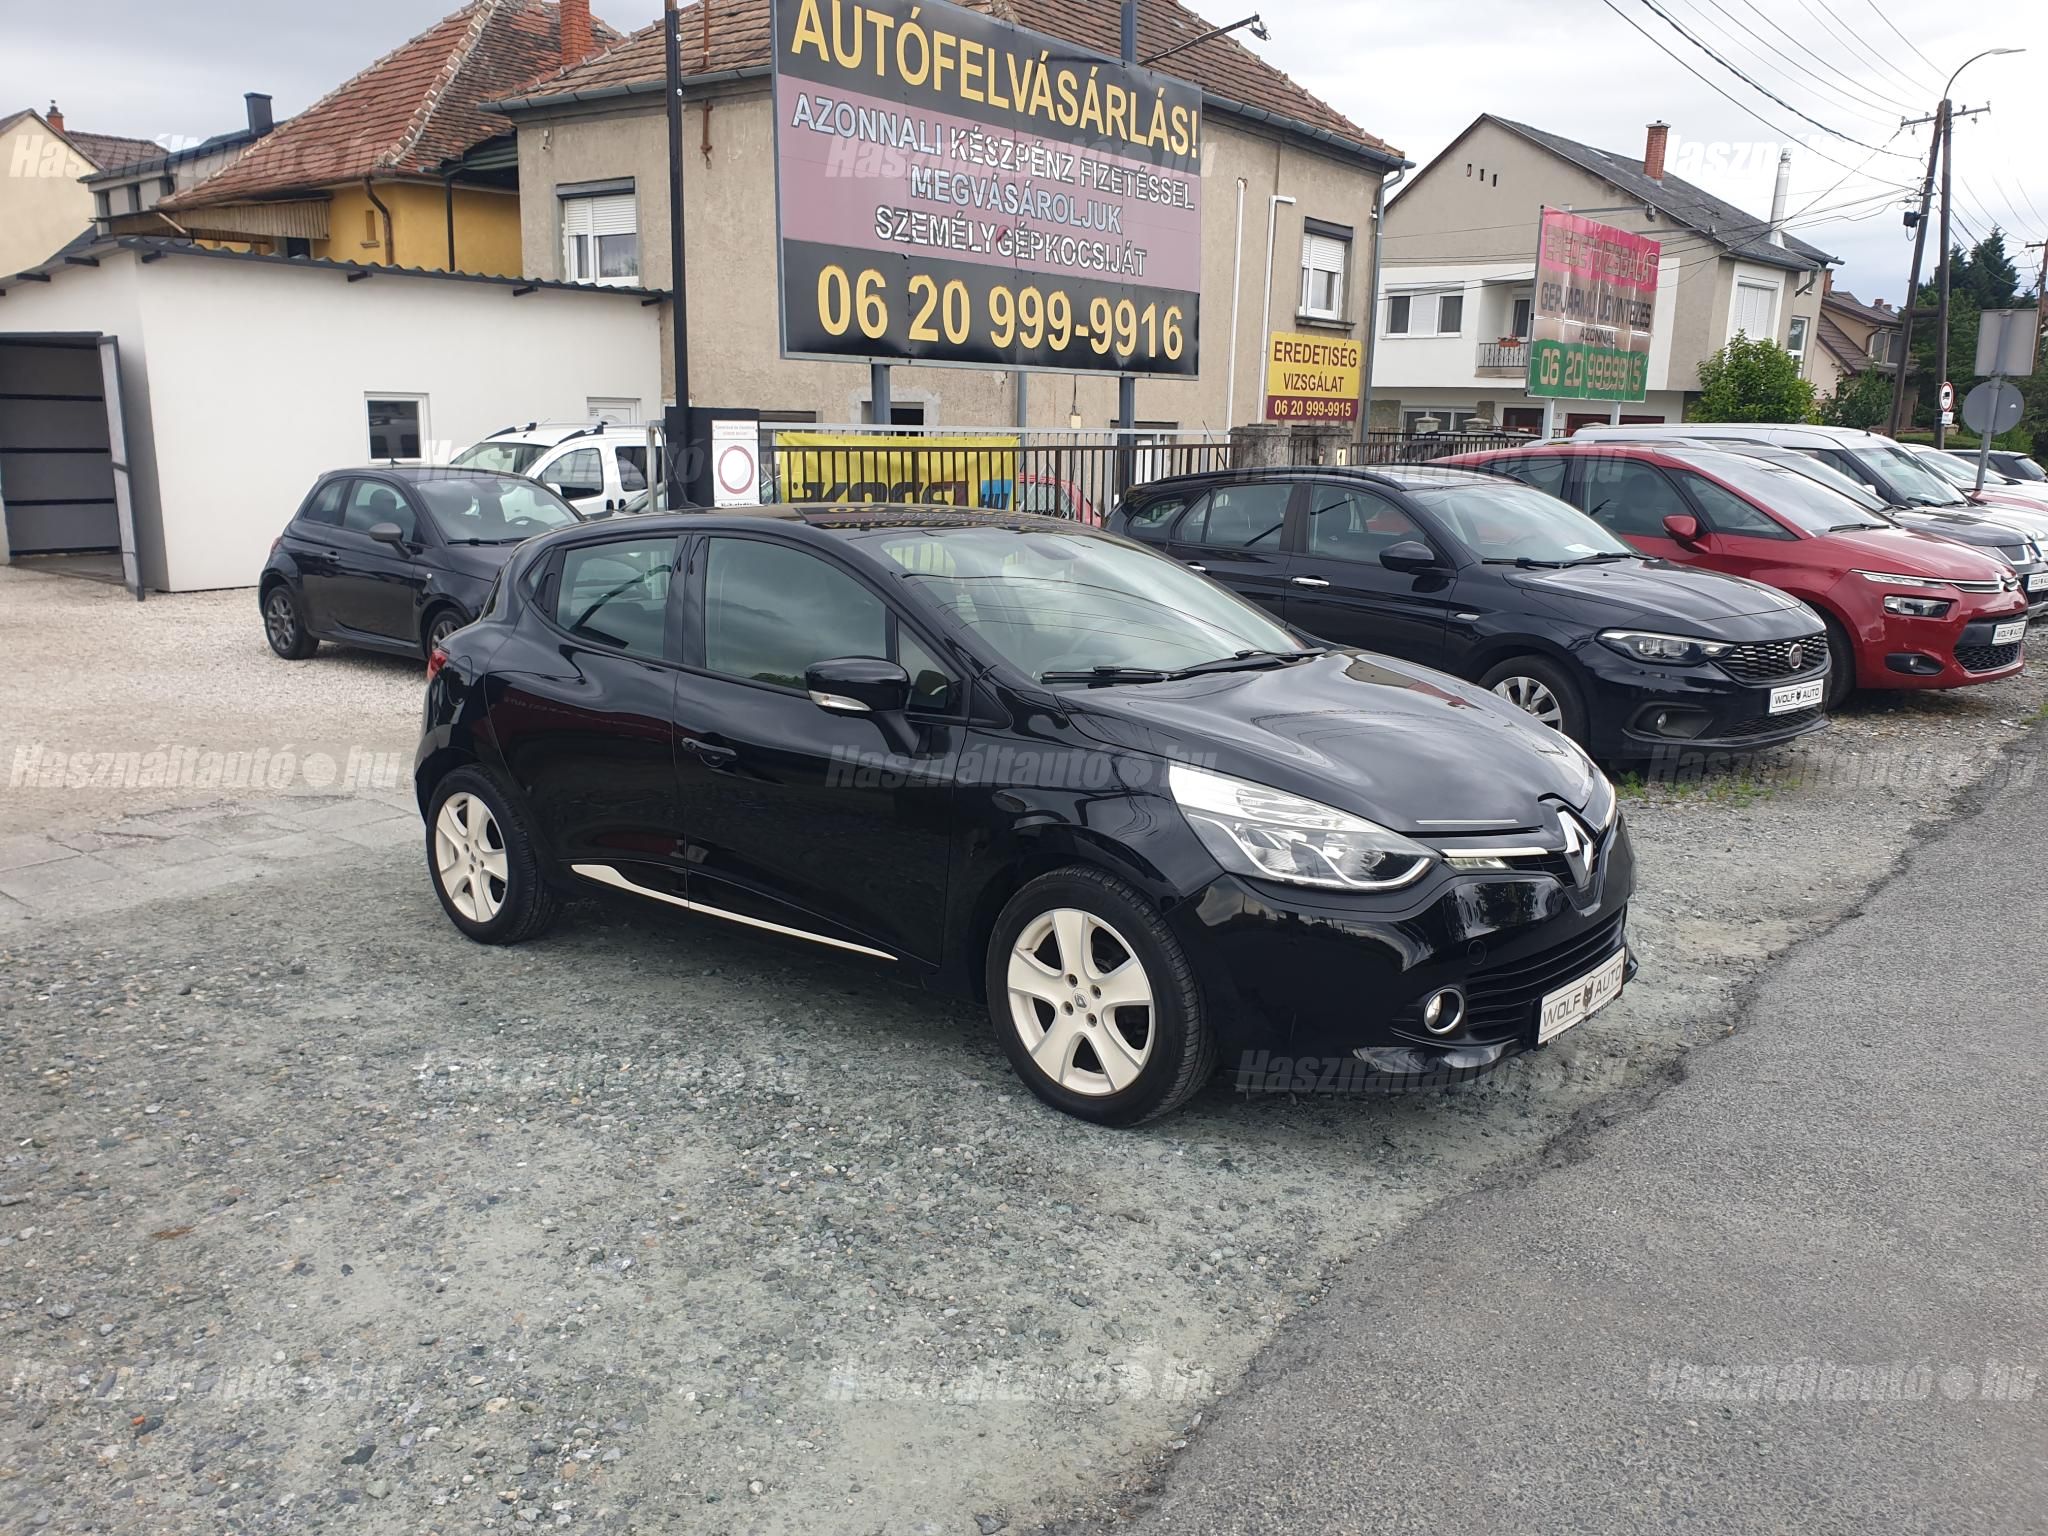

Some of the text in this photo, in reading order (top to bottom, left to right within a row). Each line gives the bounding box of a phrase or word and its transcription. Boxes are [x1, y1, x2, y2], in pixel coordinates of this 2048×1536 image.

[792, 0, 1197, 158] AUTÓFELVÁSÁRLÁS!
[792, 93, 1195, 210] AZONNALI KÉSZPÉNZ FIZETÉSSEL
[910, 163, 1122, 234] MEGVÁSÁROLJUK
[874, 204, 1148, 277] SZEMÉLYGÉPKOCSIJÁT
[816, 264, 1184, 361] 06 20 999-9916
[1274, 341, 1357, 368] EREDETISÉG
[1283, 371, 1344, 392] VIZSGÁLAT
[1540, 348, 1560, 386] 06
[1274, 400, 1351, 417] 06 20 999-9915
[1775, 688, 1820, 704] WOLF AUTO
[1543, 964, 1622, 1027] WOLF AUTO
